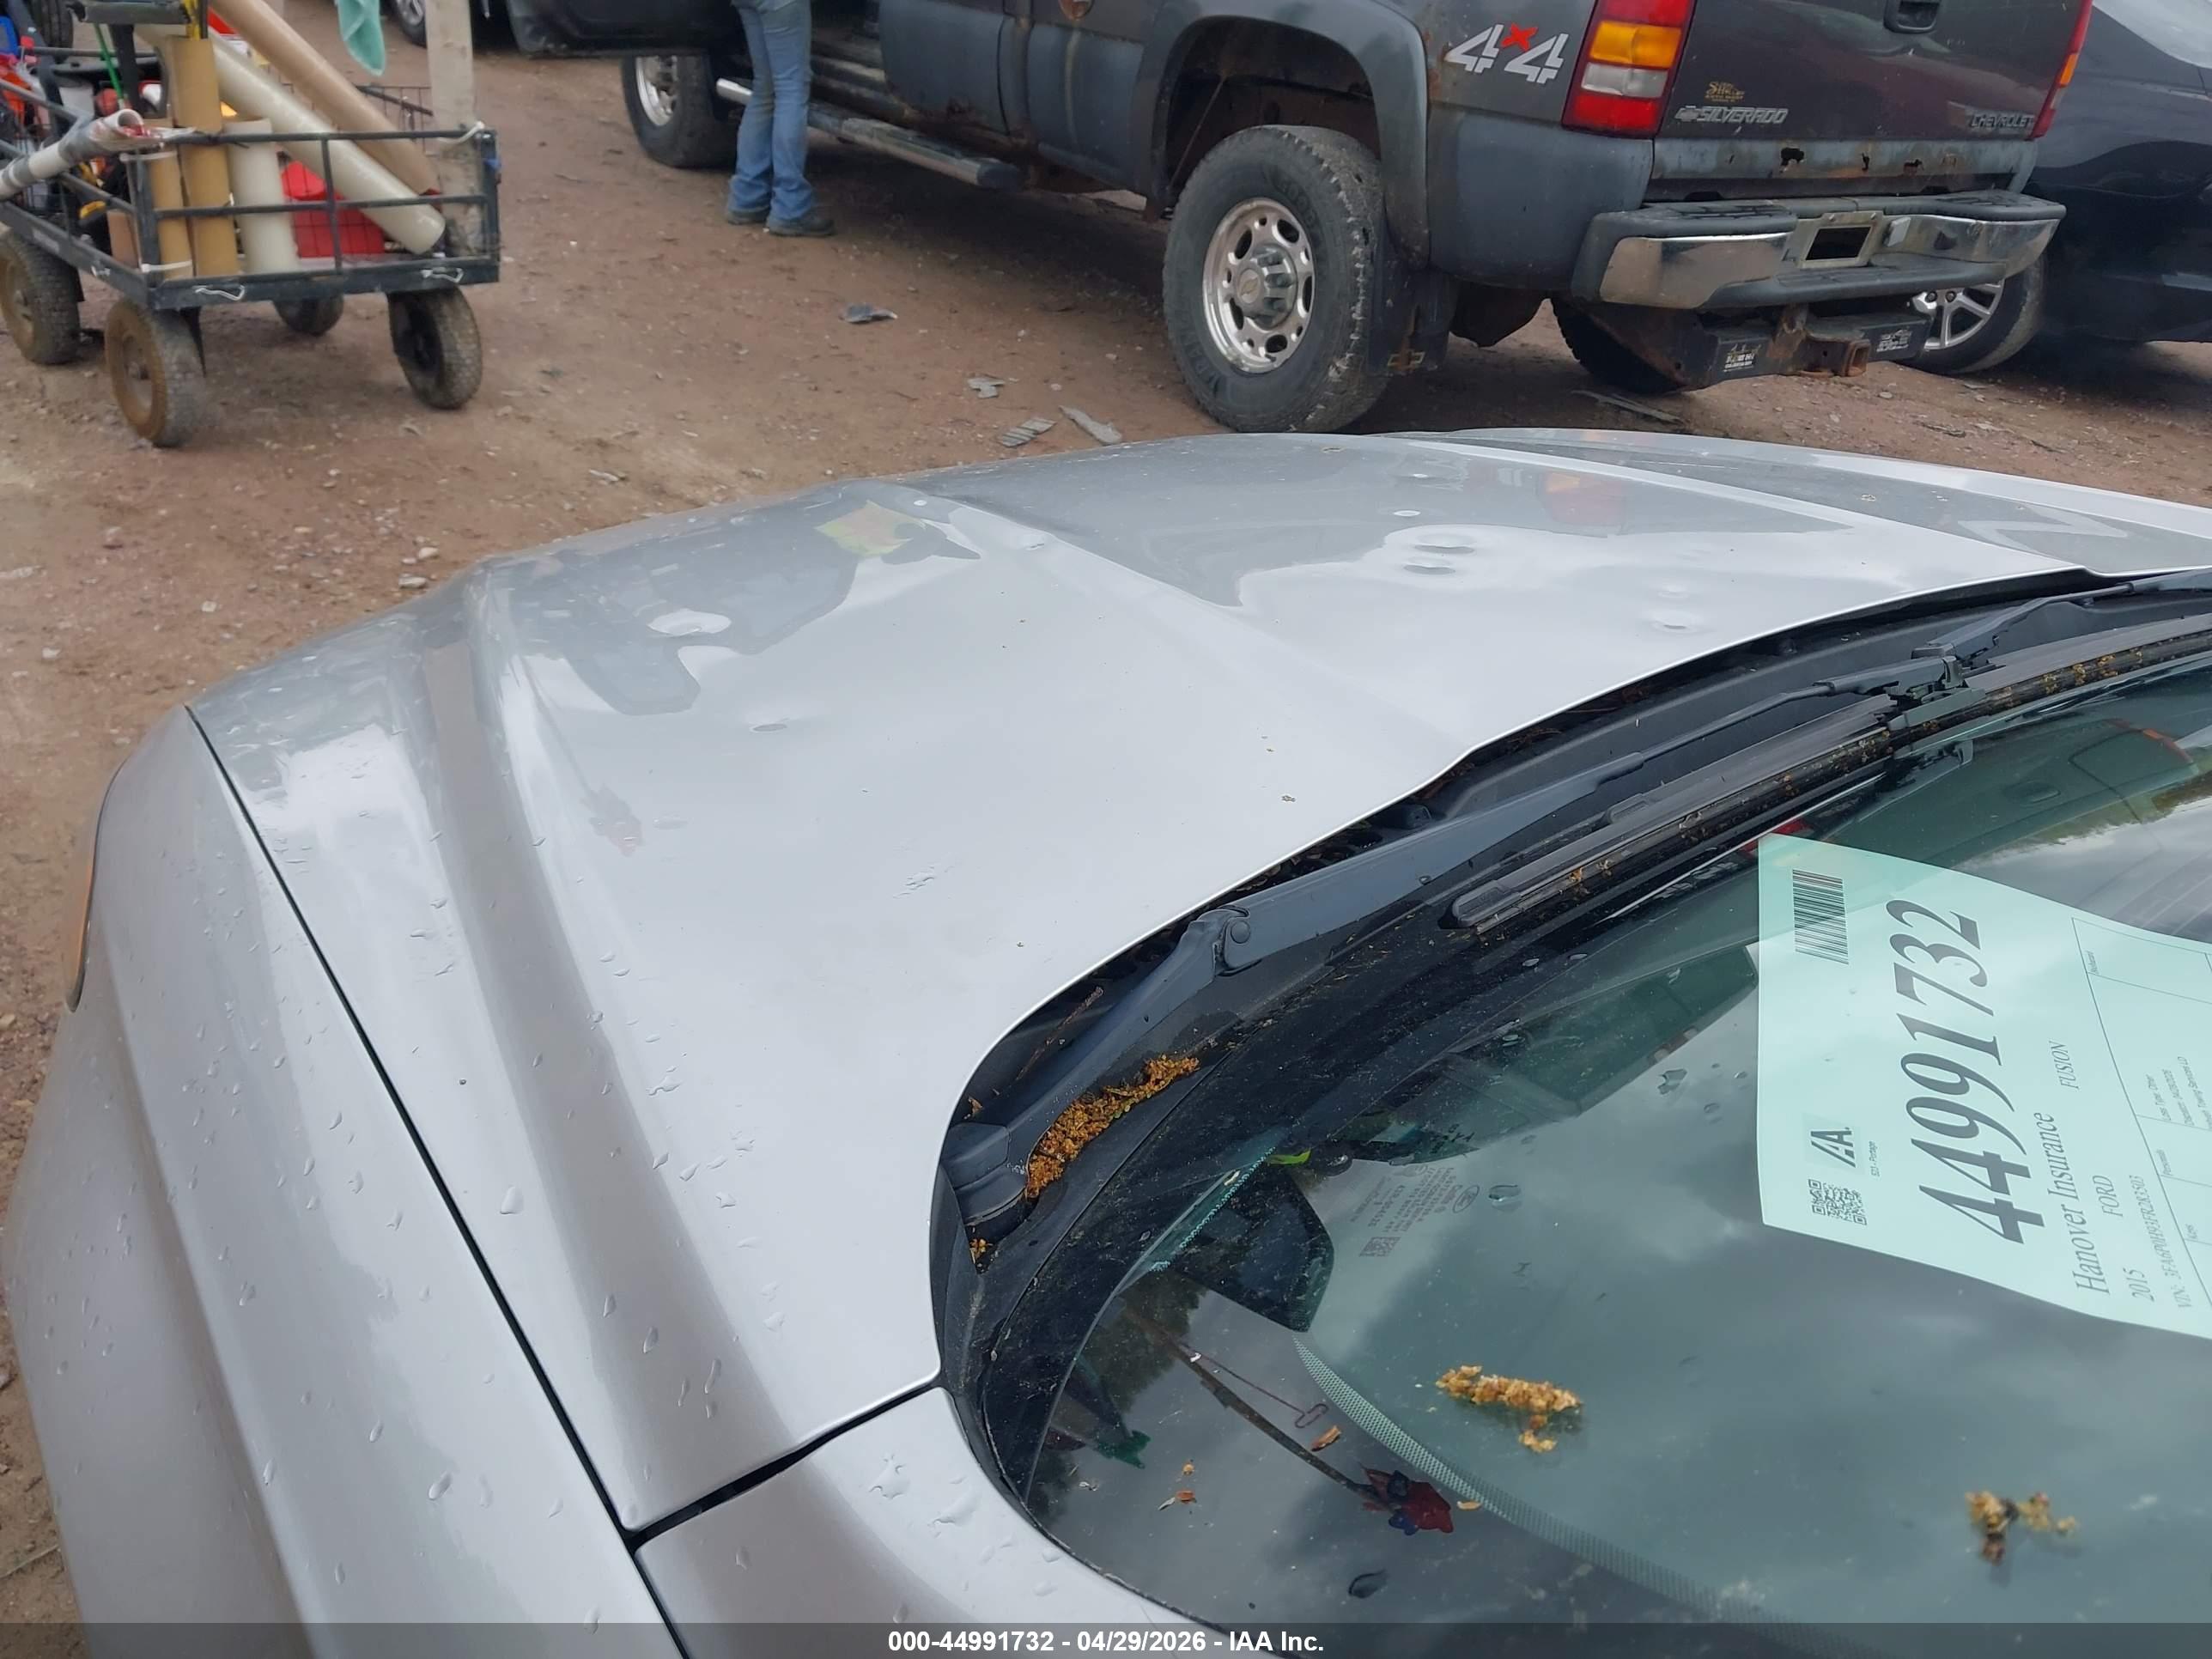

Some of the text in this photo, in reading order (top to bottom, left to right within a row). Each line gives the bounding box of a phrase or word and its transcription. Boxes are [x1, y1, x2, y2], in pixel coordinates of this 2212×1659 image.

[1695, 106, 1789, 125] SILVERADO
[1968, 111, 2034, 128] CHEVROLET
[1885, 898, 2045, 1244] 44991732
[2048, 1040, 2080, 1090] FUSION
[2034, 1112, 2111, 1295] Hanover Insurance
[2092, 1175, 2124, 1218] FORD
[2122, 1267, 2155, 1303] 2015
